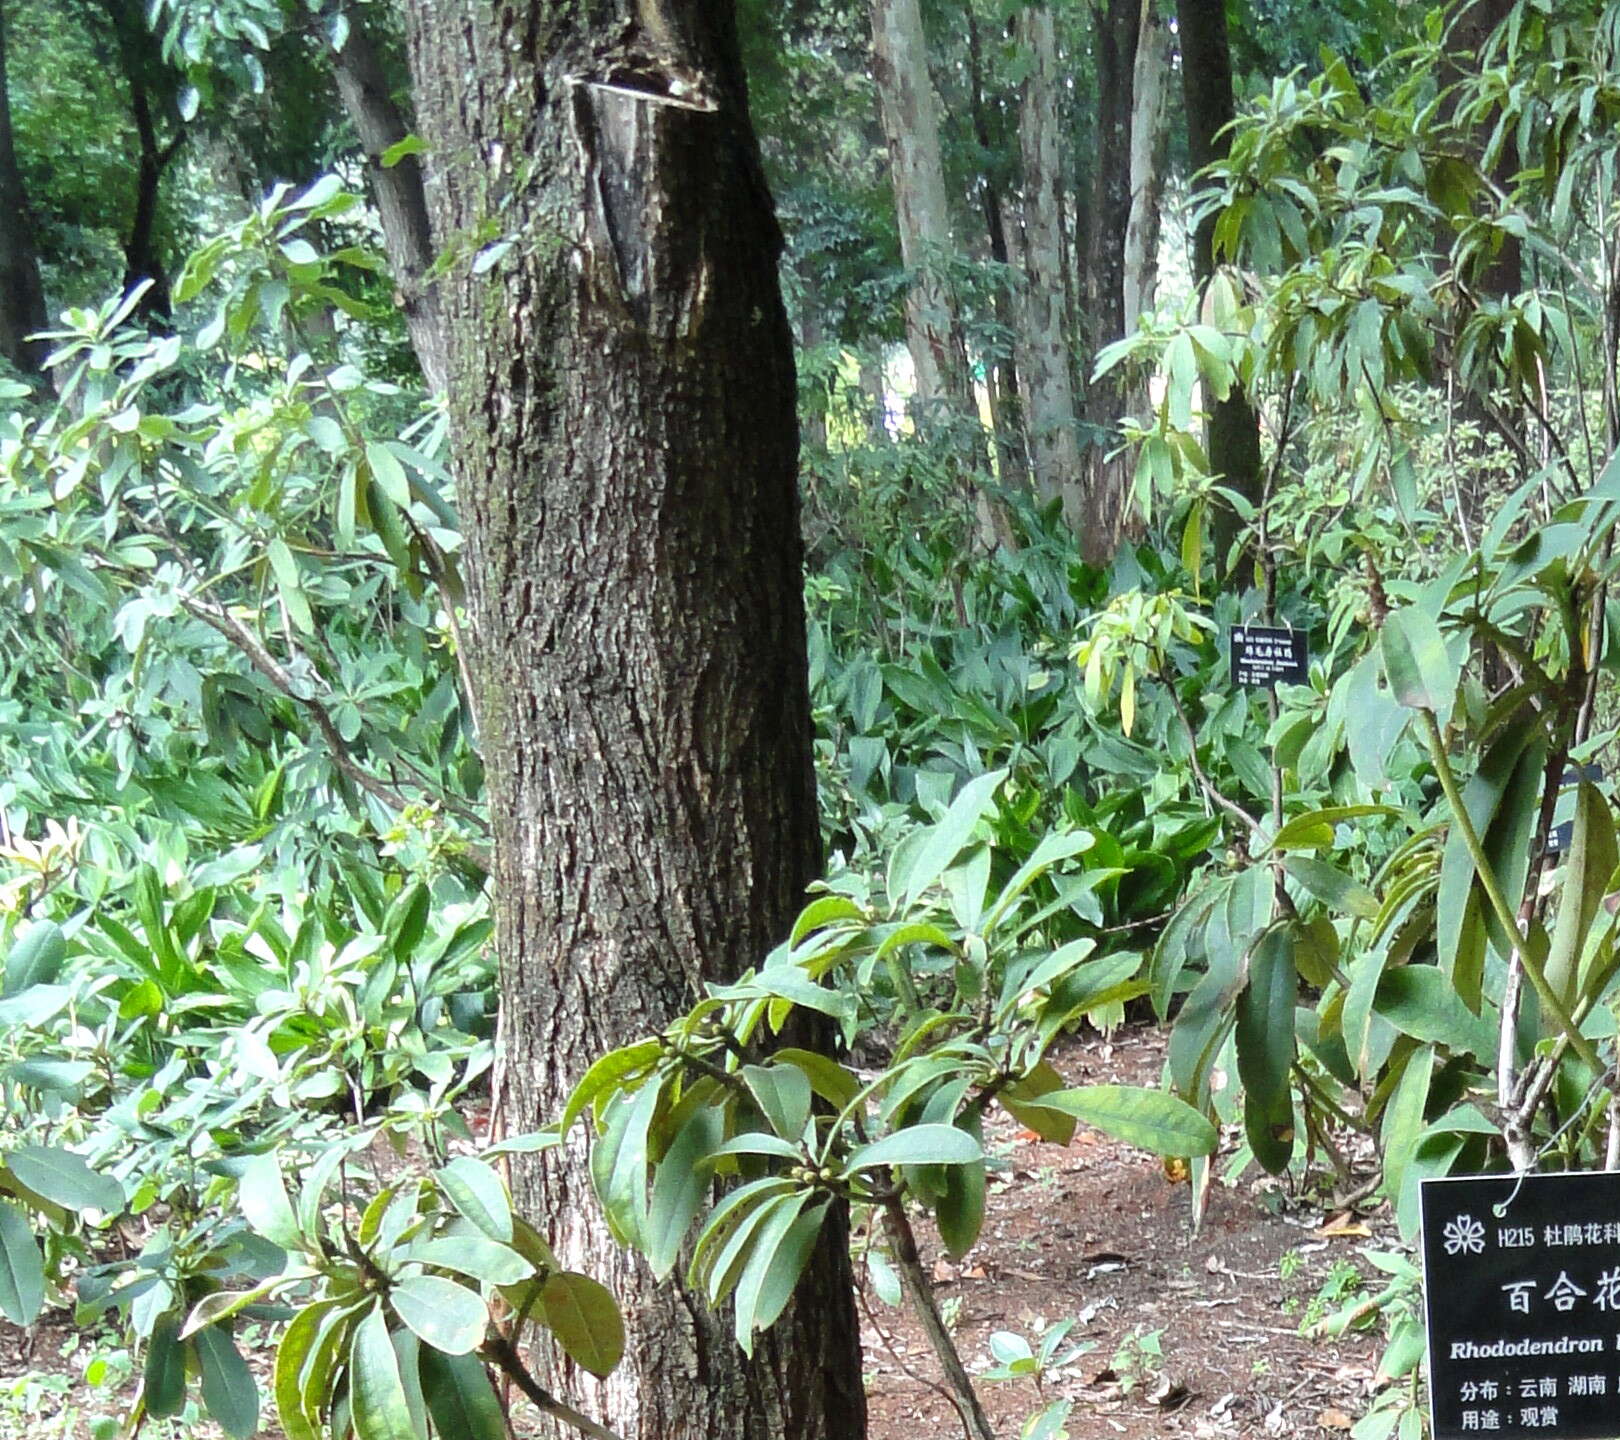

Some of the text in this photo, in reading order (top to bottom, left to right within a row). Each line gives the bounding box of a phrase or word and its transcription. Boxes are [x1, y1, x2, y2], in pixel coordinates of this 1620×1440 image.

[1497, 1226, 1535, 1248] H215
[1449, 1335, 1605, 1360] Rhododendron
[1567, 1374, 1607, 1396] 湖南
